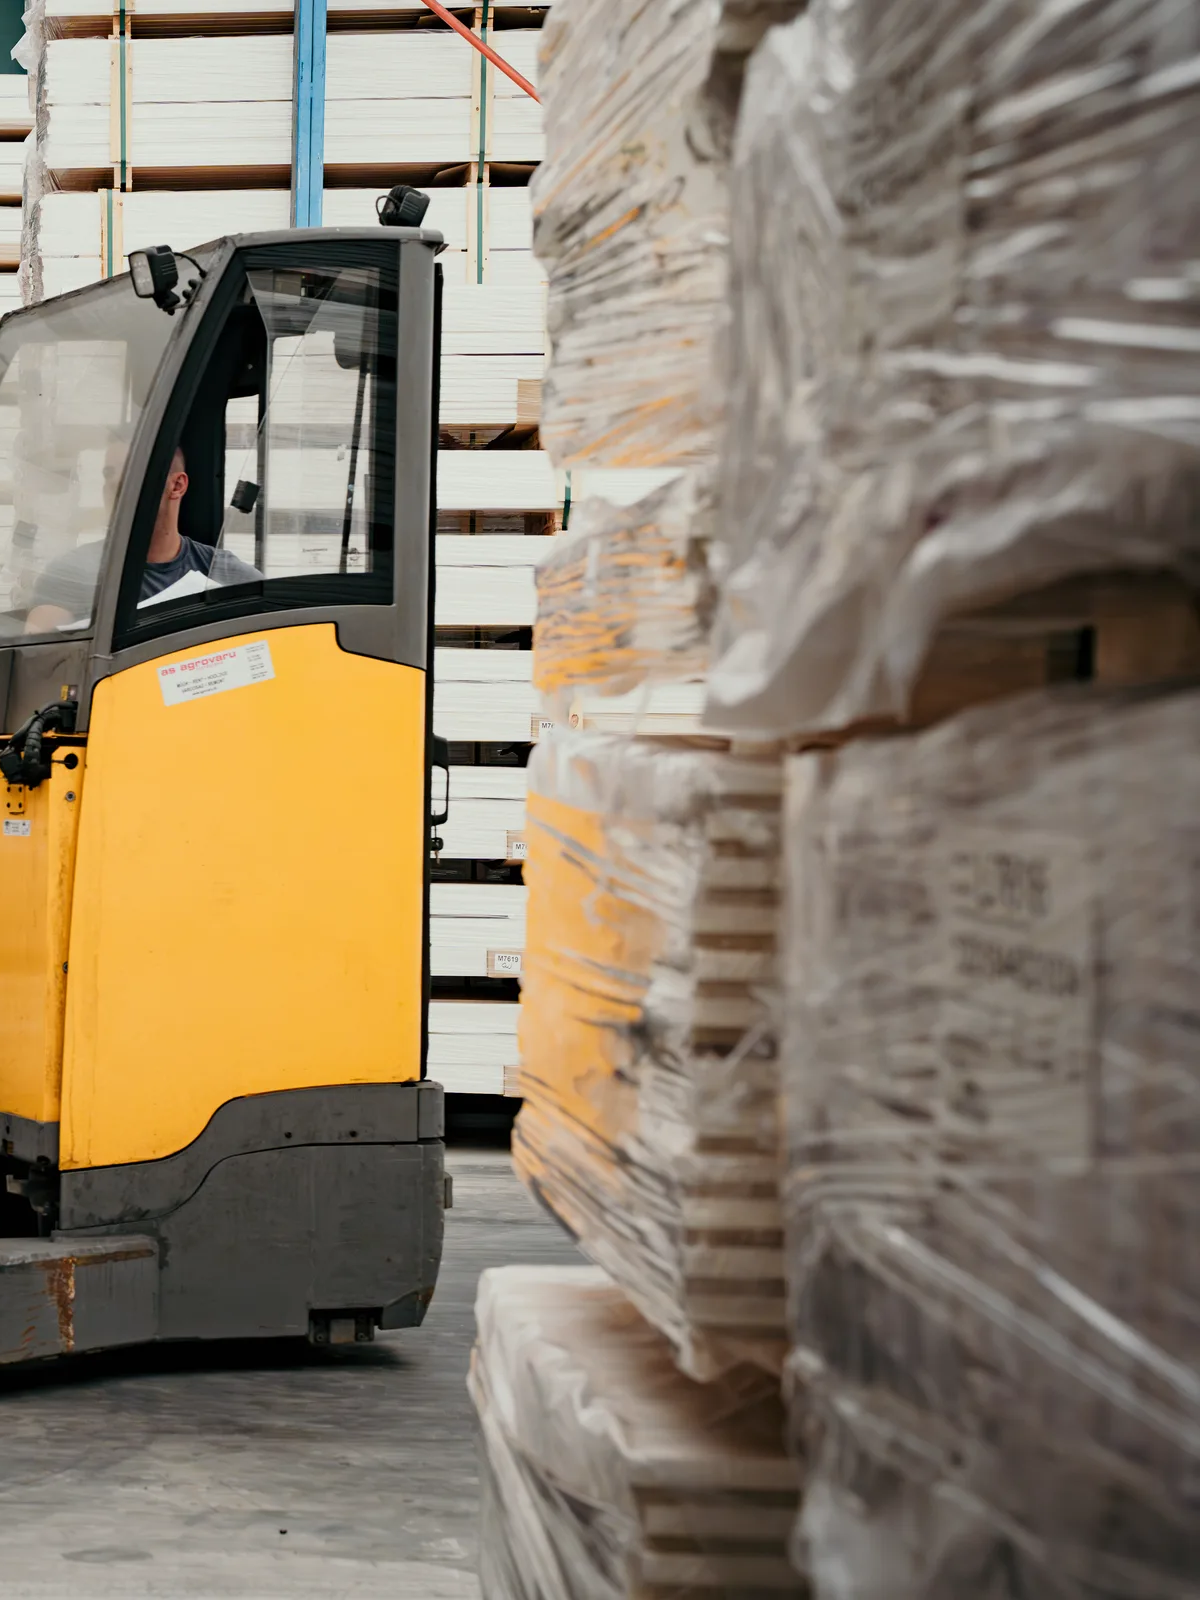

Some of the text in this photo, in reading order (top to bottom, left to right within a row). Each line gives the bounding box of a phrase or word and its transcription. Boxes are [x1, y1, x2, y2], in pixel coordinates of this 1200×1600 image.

[161, 667, 176, 676] as
[180, 651, 237, 671] agrovaru
[497, 955, 519, 963] M7619
